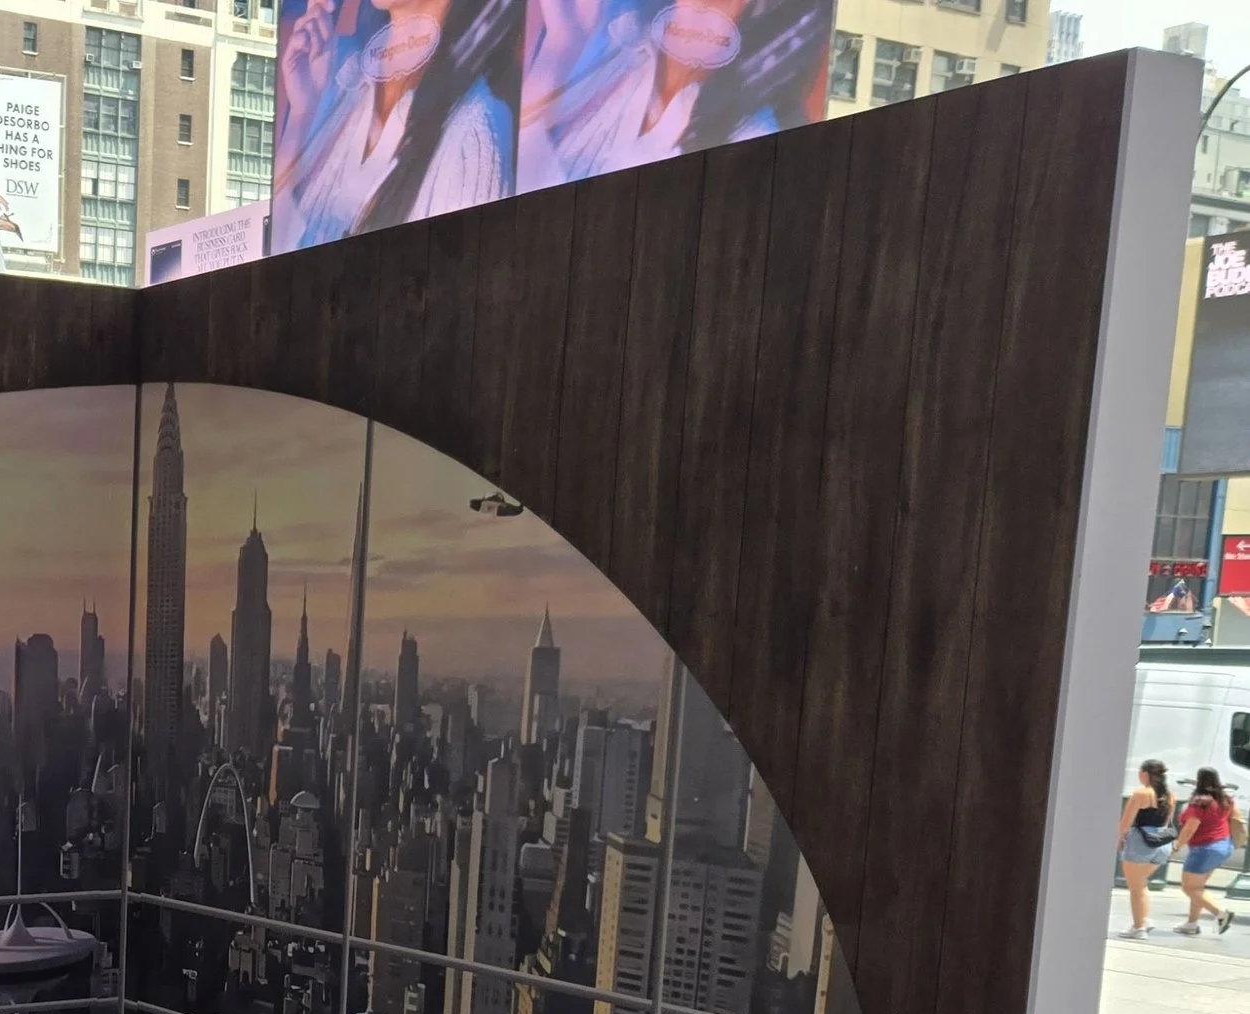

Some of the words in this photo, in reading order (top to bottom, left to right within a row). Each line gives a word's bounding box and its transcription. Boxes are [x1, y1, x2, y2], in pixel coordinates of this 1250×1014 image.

[6, 102, 40, 116] PAIGE
[5, 130, 29, 143] HAS
[31, 134, 40, 144] A
[31, 147, 53, 160] FOR
[3, 157, 41, 172] SHOES
[6, 179, 39, 195] DSW
[1210, 240, 1238, 257] THE
[1207, 249, 1247, 270] JOE
